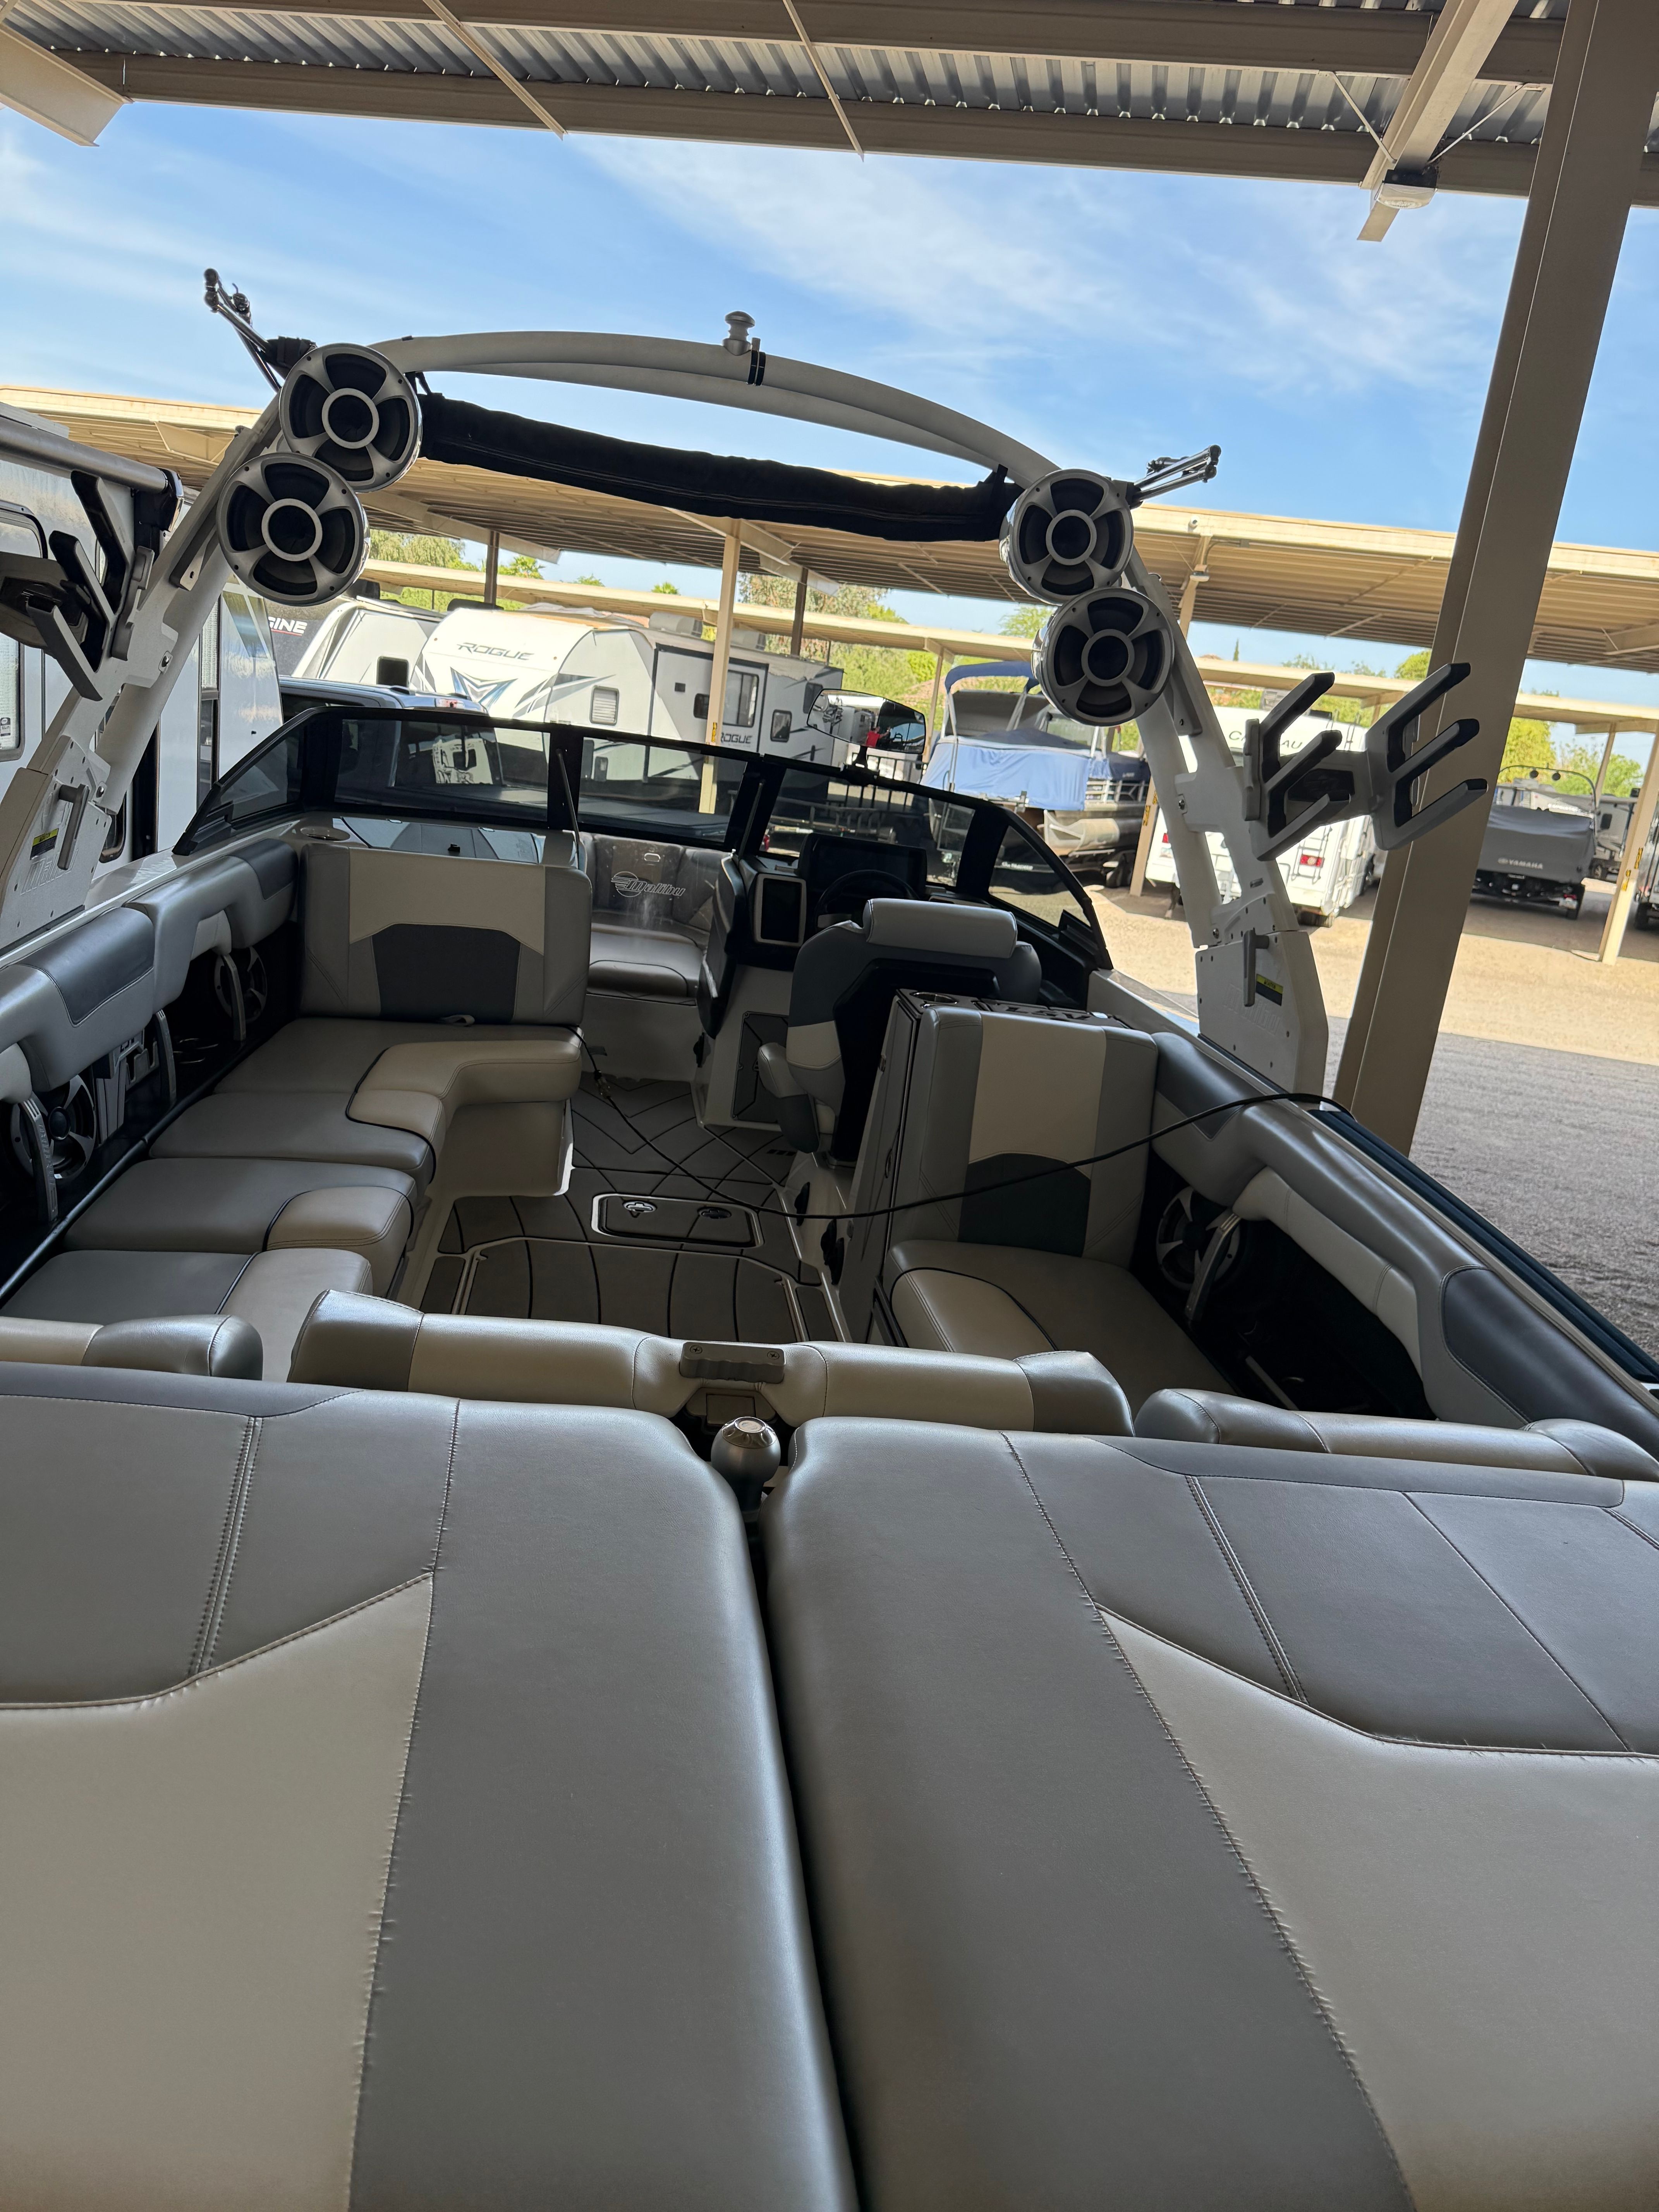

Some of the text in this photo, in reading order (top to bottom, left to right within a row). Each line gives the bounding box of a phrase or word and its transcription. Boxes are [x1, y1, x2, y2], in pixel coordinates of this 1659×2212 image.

[457, 642, 534, 661] ROGUE
[1509, 859, 1543, 869] YAMAHA
[625, 879, 686, 896] Malibu
